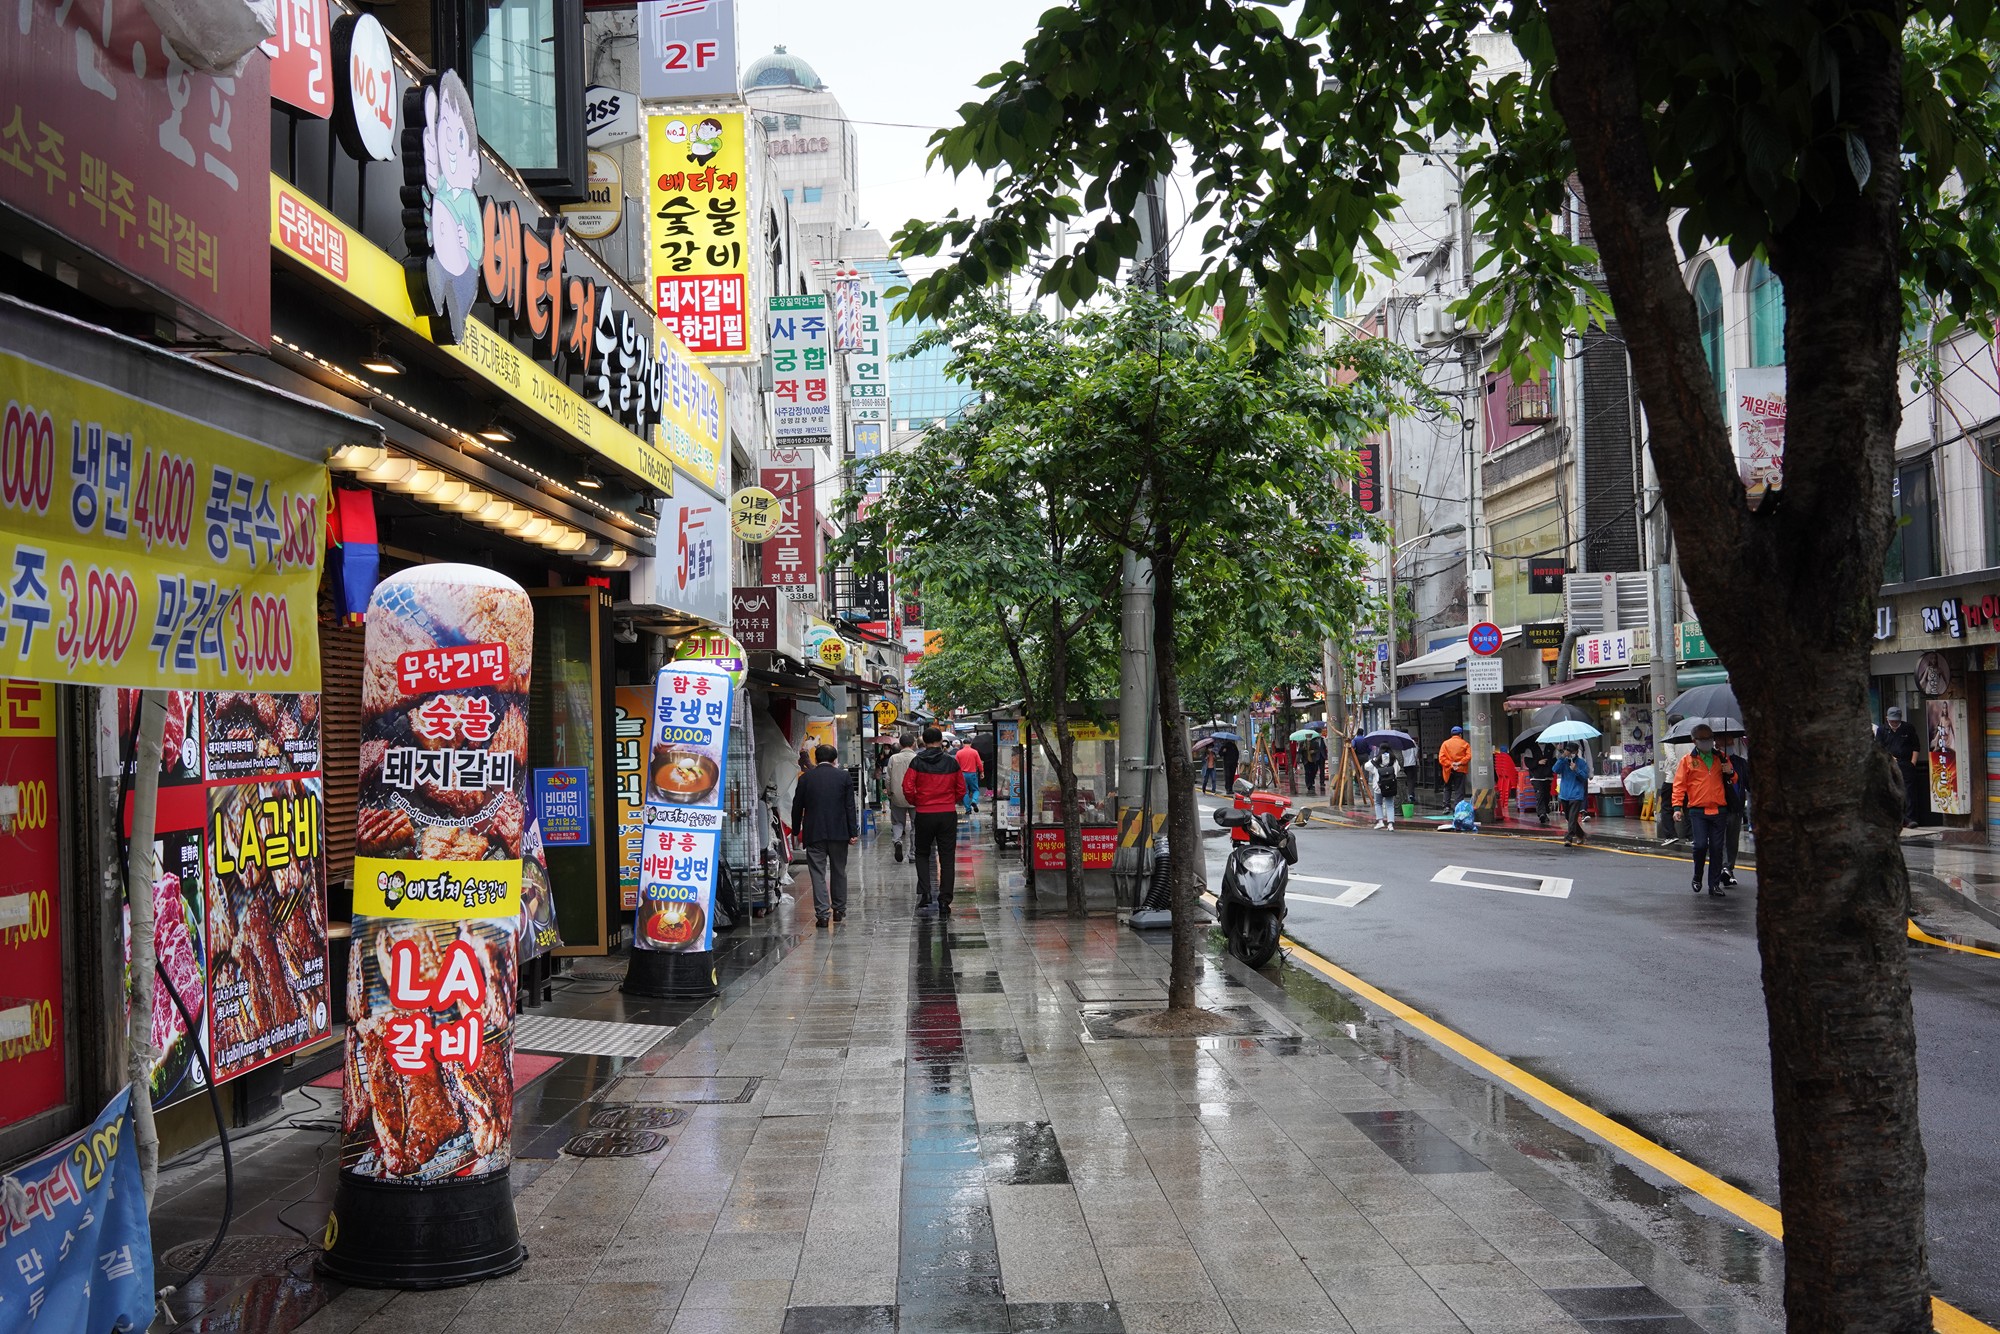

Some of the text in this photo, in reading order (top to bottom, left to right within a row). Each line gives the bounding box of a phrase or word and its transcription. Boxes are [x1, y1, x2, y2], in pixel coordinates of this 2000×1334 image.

[665, 42, 716, 70] 2F
[585, 95, 620, 124] ass
[657, 165, 738, 192] 배터져
[656, 196, 741, 236] 숯불
[147, 195, 218, 294] 막걸리
[279, 195, 344, 277] 무한리필
[659, 240, 741, 272] 갈비
[659, 279, 741, 313] 돼지갈비
[772, 316, 826, 341] 사주
[773, 347, 827, 372] 궁합
[775, 378, 827, 403] 작명
[858, 410, 880, 419] 4층
[72, 425, 132, 537] 냉면
[205, 467, 281, 566] 콩국수
[740, 495, 769, 510] 이불
[738, 512, 767, 527] 커텐
[774, 471, 803, 572] 가자주류
[771, 573, 808, 583] 전문점
[1533, 568, 1565, 576] HOTARU
[58, 564, 138, 671] 3,000
[150, 575, 237, 673] 막걸리
[233, 594, 293, 682] 3,000
[685, 637, 730, 658] 커피
[735, 631, 766, 643] 백화점
[1533, 637, 1559, 645] HERACLES
[402, 645, 504, 690] 무한리필
[671, 676, 713, 697] 함흥
[422, 697, 493, 739] 숯불
[657, 696, 723, 727] 물냉면
[663, 728, 712, 745] 8,000원
[209, 757, 280, 772] Grilled Marinated Pork (Galbi)
[382, 750, 515, 791] 돼지갈비
[391, 792, 506, 828] grilled marinated pork galbi
[545, 791, 577, 804] 비대면
[545, 804, 578, 818] 칸막이
[214, 794, 319, 876] LA갈비
[658, 832, 698, 853] 함흥
[643, 853, 709, 882] 비빔냉면
[407, 874, 507, 907] 배터져 숯불갈비
[649, 884, 697, 901] 9,000원
[398, 946, 480, 1002] LA
[319, 1011, 324, 1027] 7
[391, 1016, 479, 1069] 갈비
